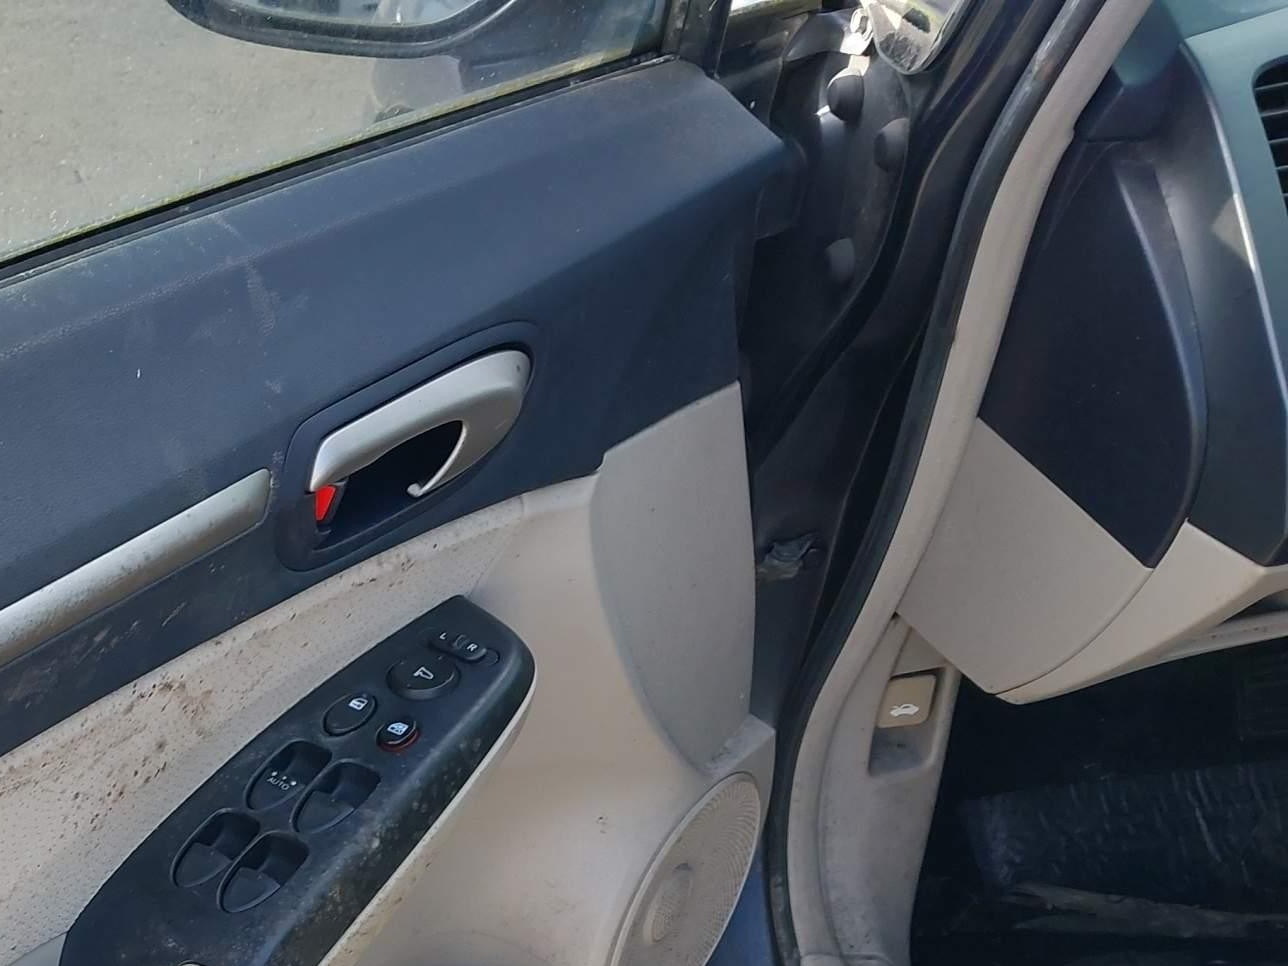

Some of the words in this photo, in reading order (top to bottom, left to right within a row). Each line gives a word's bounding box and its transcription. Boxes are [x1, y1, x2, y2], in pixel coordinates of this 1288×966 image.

[439, 632, 447, 640] L
[466, 643, 478, 652] R
[267, 777, 290, 790] AUTO
